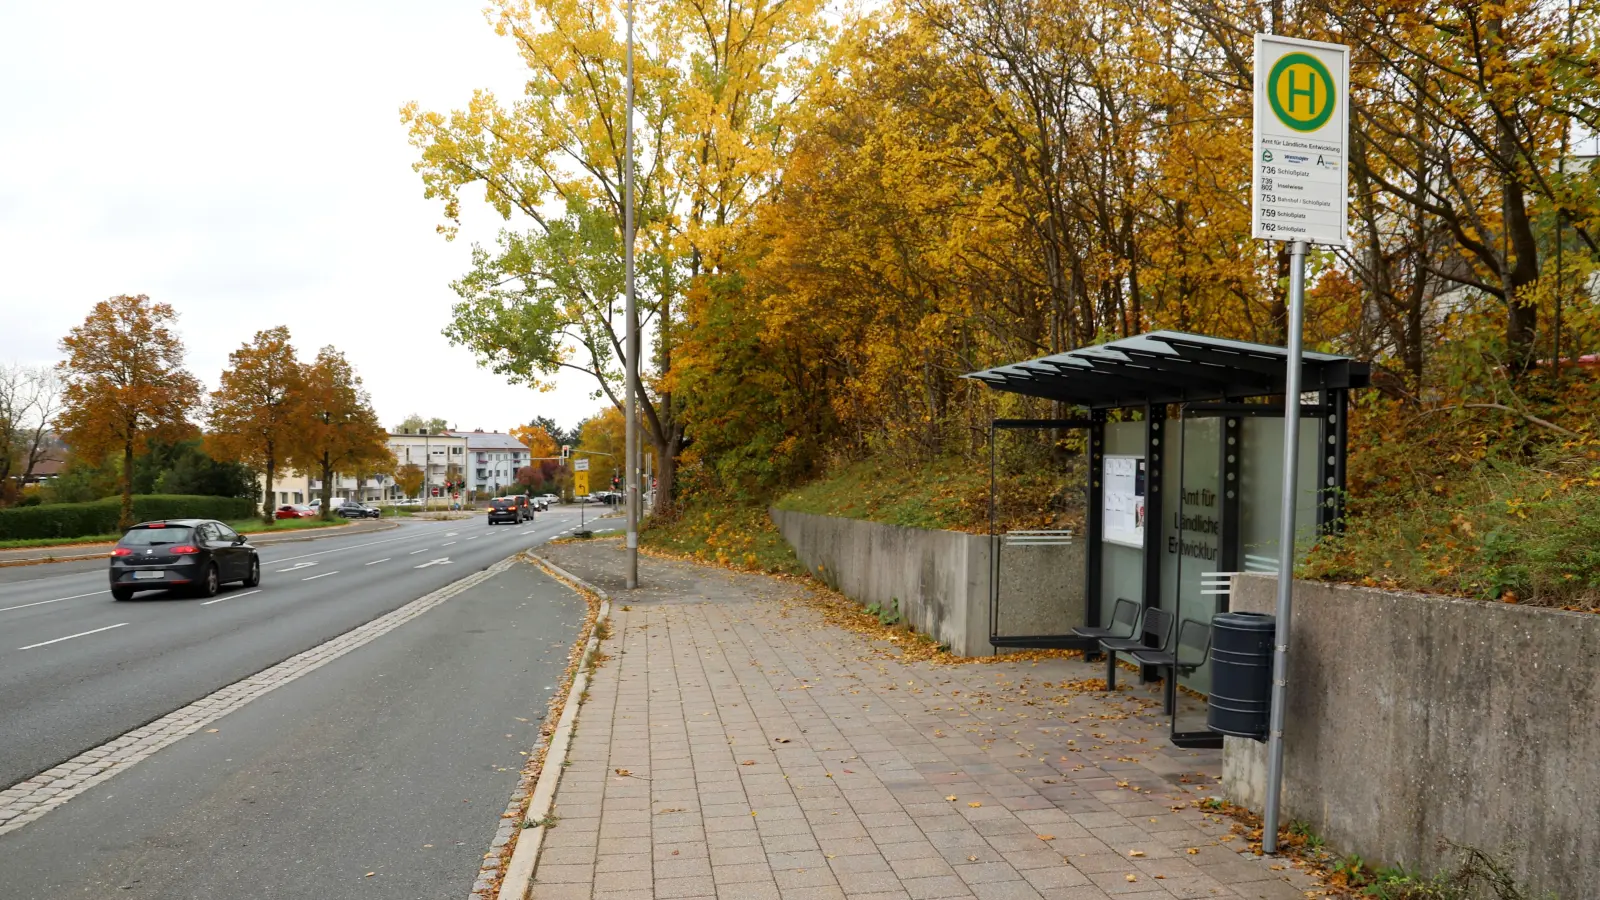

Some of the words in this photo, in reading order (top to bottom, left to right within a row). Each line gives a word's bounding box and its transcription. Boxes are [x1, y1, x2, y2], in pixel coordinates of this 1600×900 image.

[1289, 70, 1315, 114] H
[1282, 140, 1308, 148] Ländliche
[1308, 144, 1340, 154] Entwicklung
[1316, 154, 1324, 166] A
[1262, 166, 1276, 174] 736
[1278, 168, 1310, 177] Schloßplatz
[1262, 194, 1276, 202] 753
[1261, 208, 1276, 217] 759
[1261, 223, 1276, 231] 762
[1182, 488, 1199, 506] Amt
[1201, 488, 1216, 507] für
[1174, 512, 1219, 535] Ländliche
